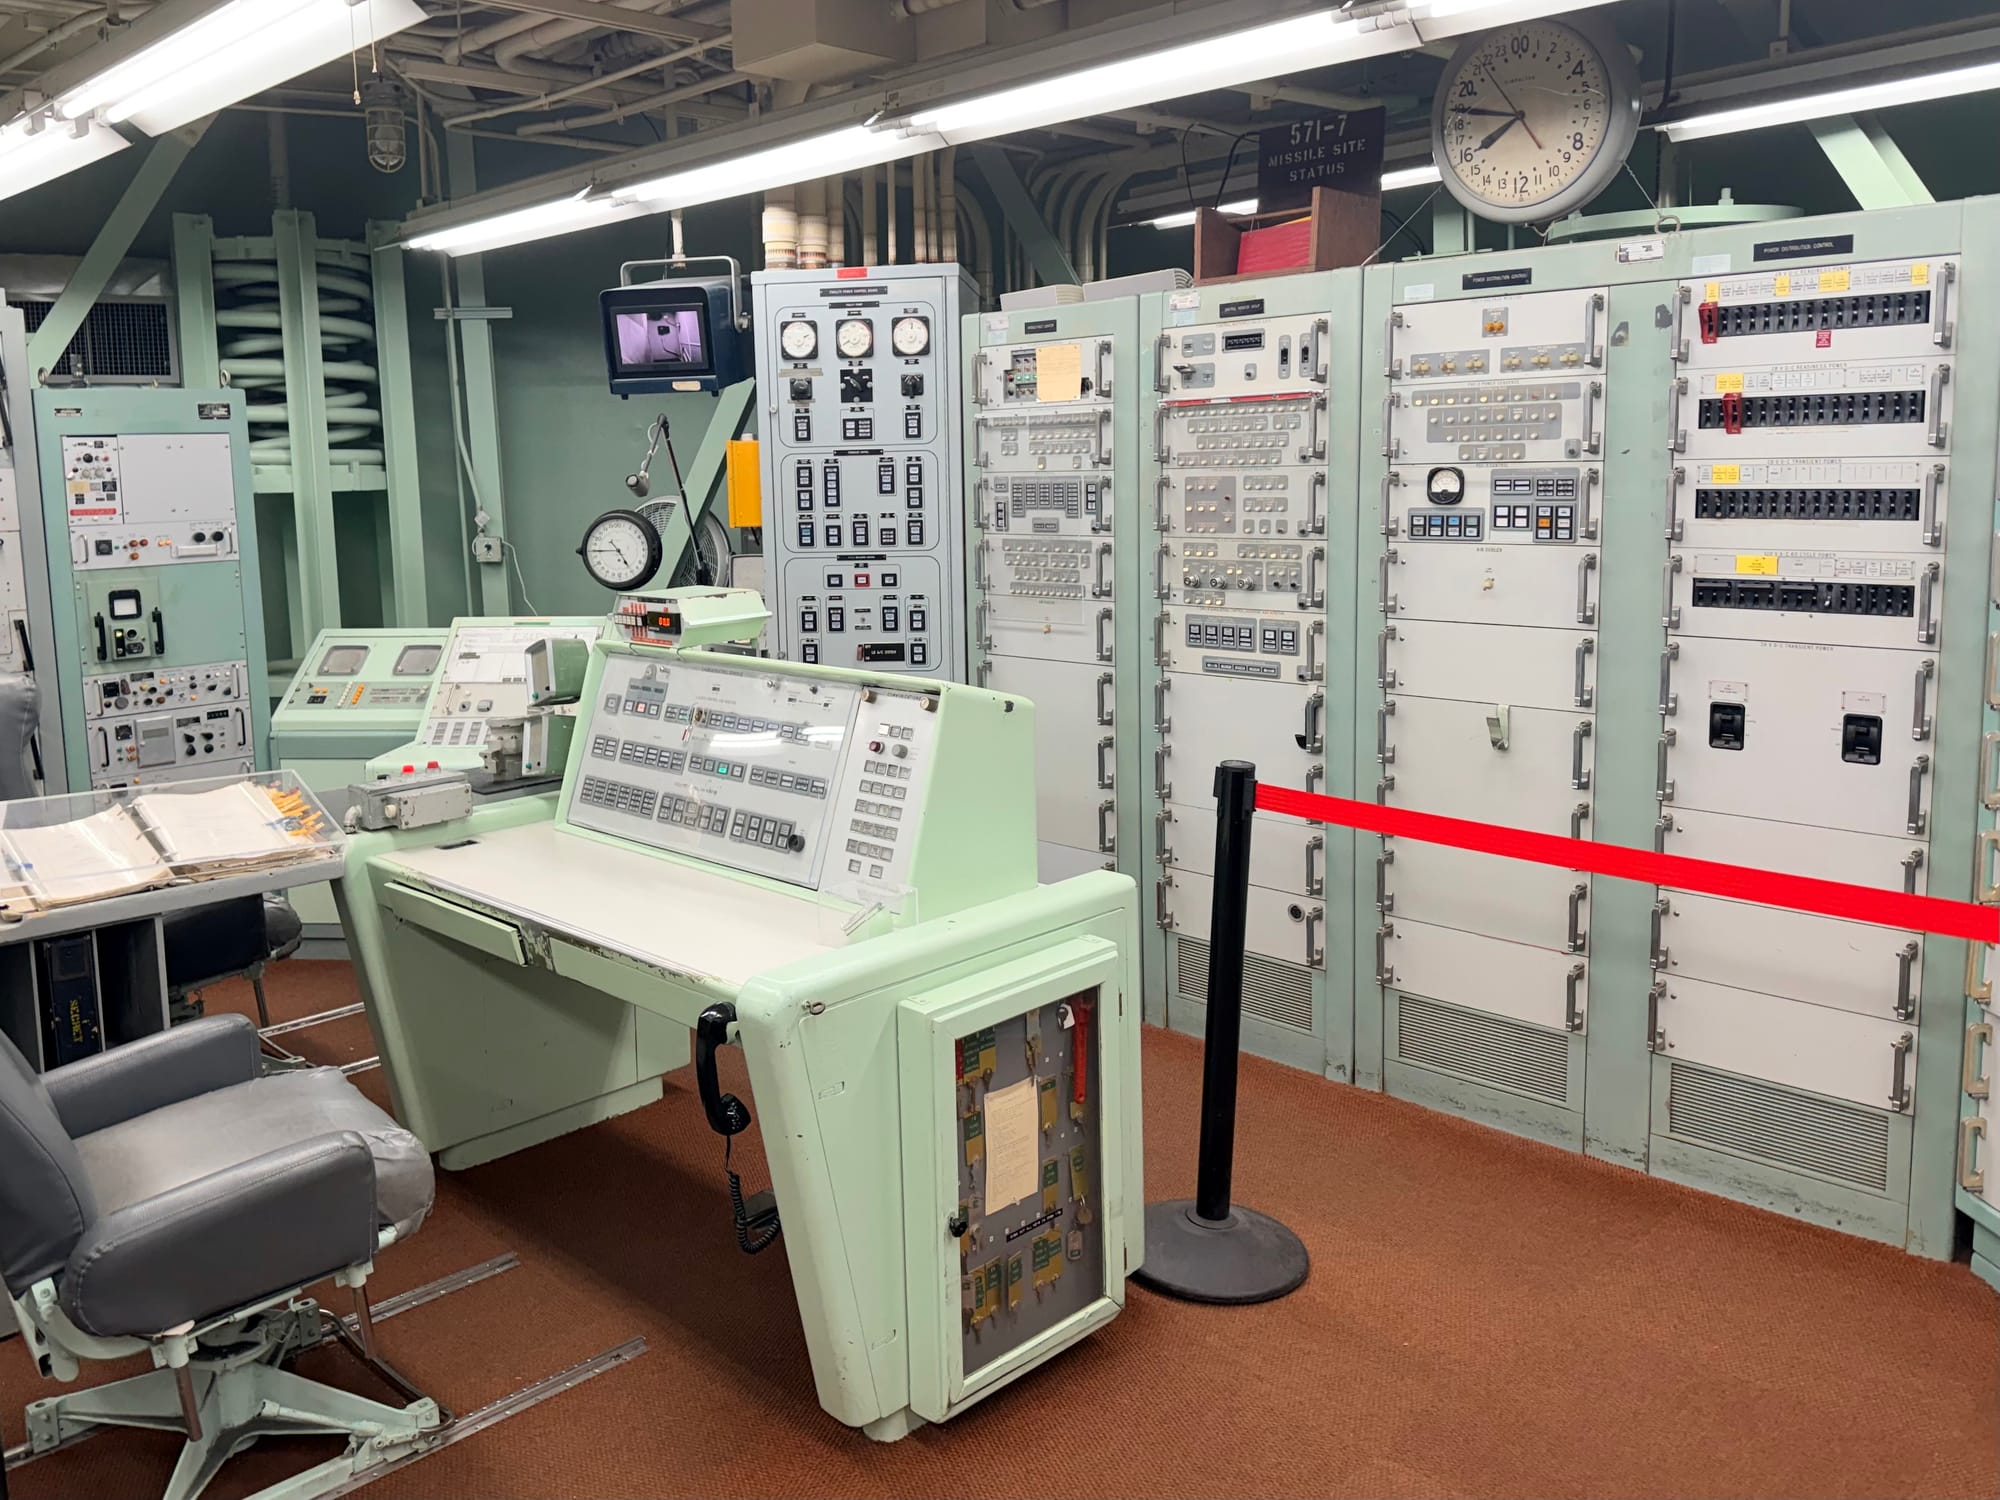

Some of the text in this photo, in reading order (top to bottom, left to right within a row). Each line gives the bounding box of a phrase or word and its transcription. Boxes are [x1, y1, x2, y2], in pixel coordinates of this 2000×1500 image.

[1495, 44, 1507, 58] 23
[1511, 34, 1530, 55] 00
[1549, 42, 1557, 53] 2
[1482, 53, 1494, 66] 22
[1564, 51, 1571, 63] 3
[1472, 64, 1481, 76] 21
[1571, 59, 1586, 77] 4
[1458, 80, 1474, 97] 20
[1581, 81, 1590, 94] 5
[1583, 98, 1591, 110] 6
[1454, 119, 1464, 131] 18
[1582, 116, 1590, 128] 7
[1290, 114, 1347, 145] 571-7
[1455, 134, 1465, 145] 17
[1572, 132, 1584, 151] 8
[1268, 138, 1366, 168] MISSILE SITE
[1460, 147, 1474, 164] 16
[1562, 151, 1571, 163] 9
[1289, 162, 1345, 182] STATUS
[1470, 164, 1481, 176] 15
[1548, 165, 1560, 178] 10
[1482, 174, 1491, 187] 14
[1498, 178, 1507, 190] 13
[1513, 176, 1529, 195] 12
[1534, 173, 1542, 186] 11
[70, 1000, 83, 1042] SECRET
